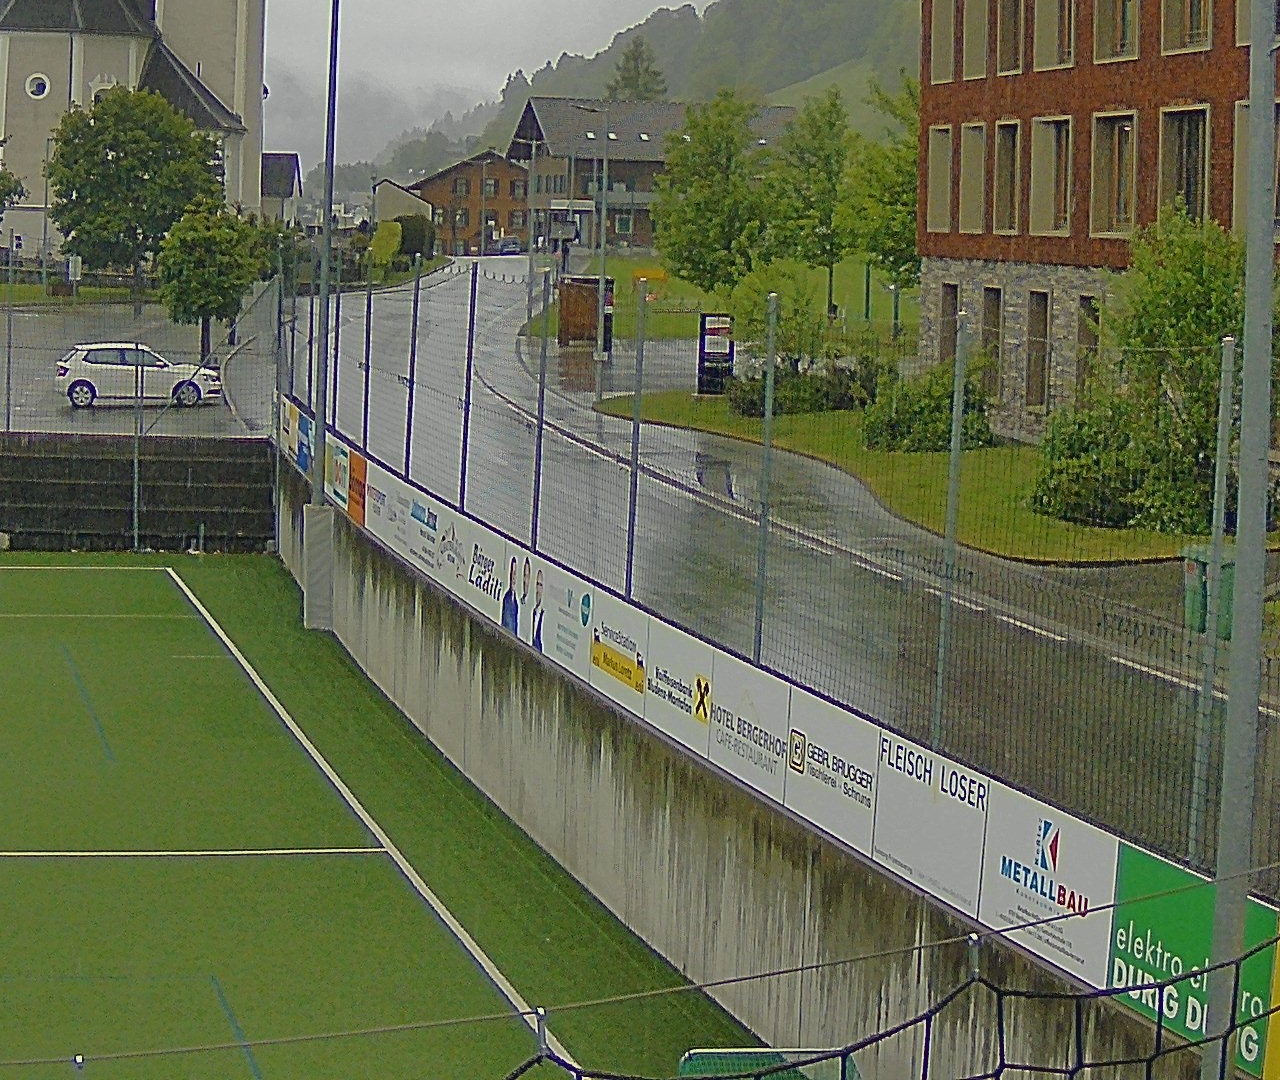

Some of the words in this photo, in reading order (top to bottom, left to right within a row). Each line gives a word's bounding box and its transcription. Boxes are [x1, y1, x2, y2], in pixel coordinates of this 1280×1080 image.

[711, 703, 735, 732] HOTEL
[737, 717, 787, 759] BERGERHOF
[832, 756, 873, 792] BRUGGER
[880, 737, 933, 787] FLEISCH
[940, 765, 987, 812] LOSER
[1116, 920, 1182, 978] elektro
